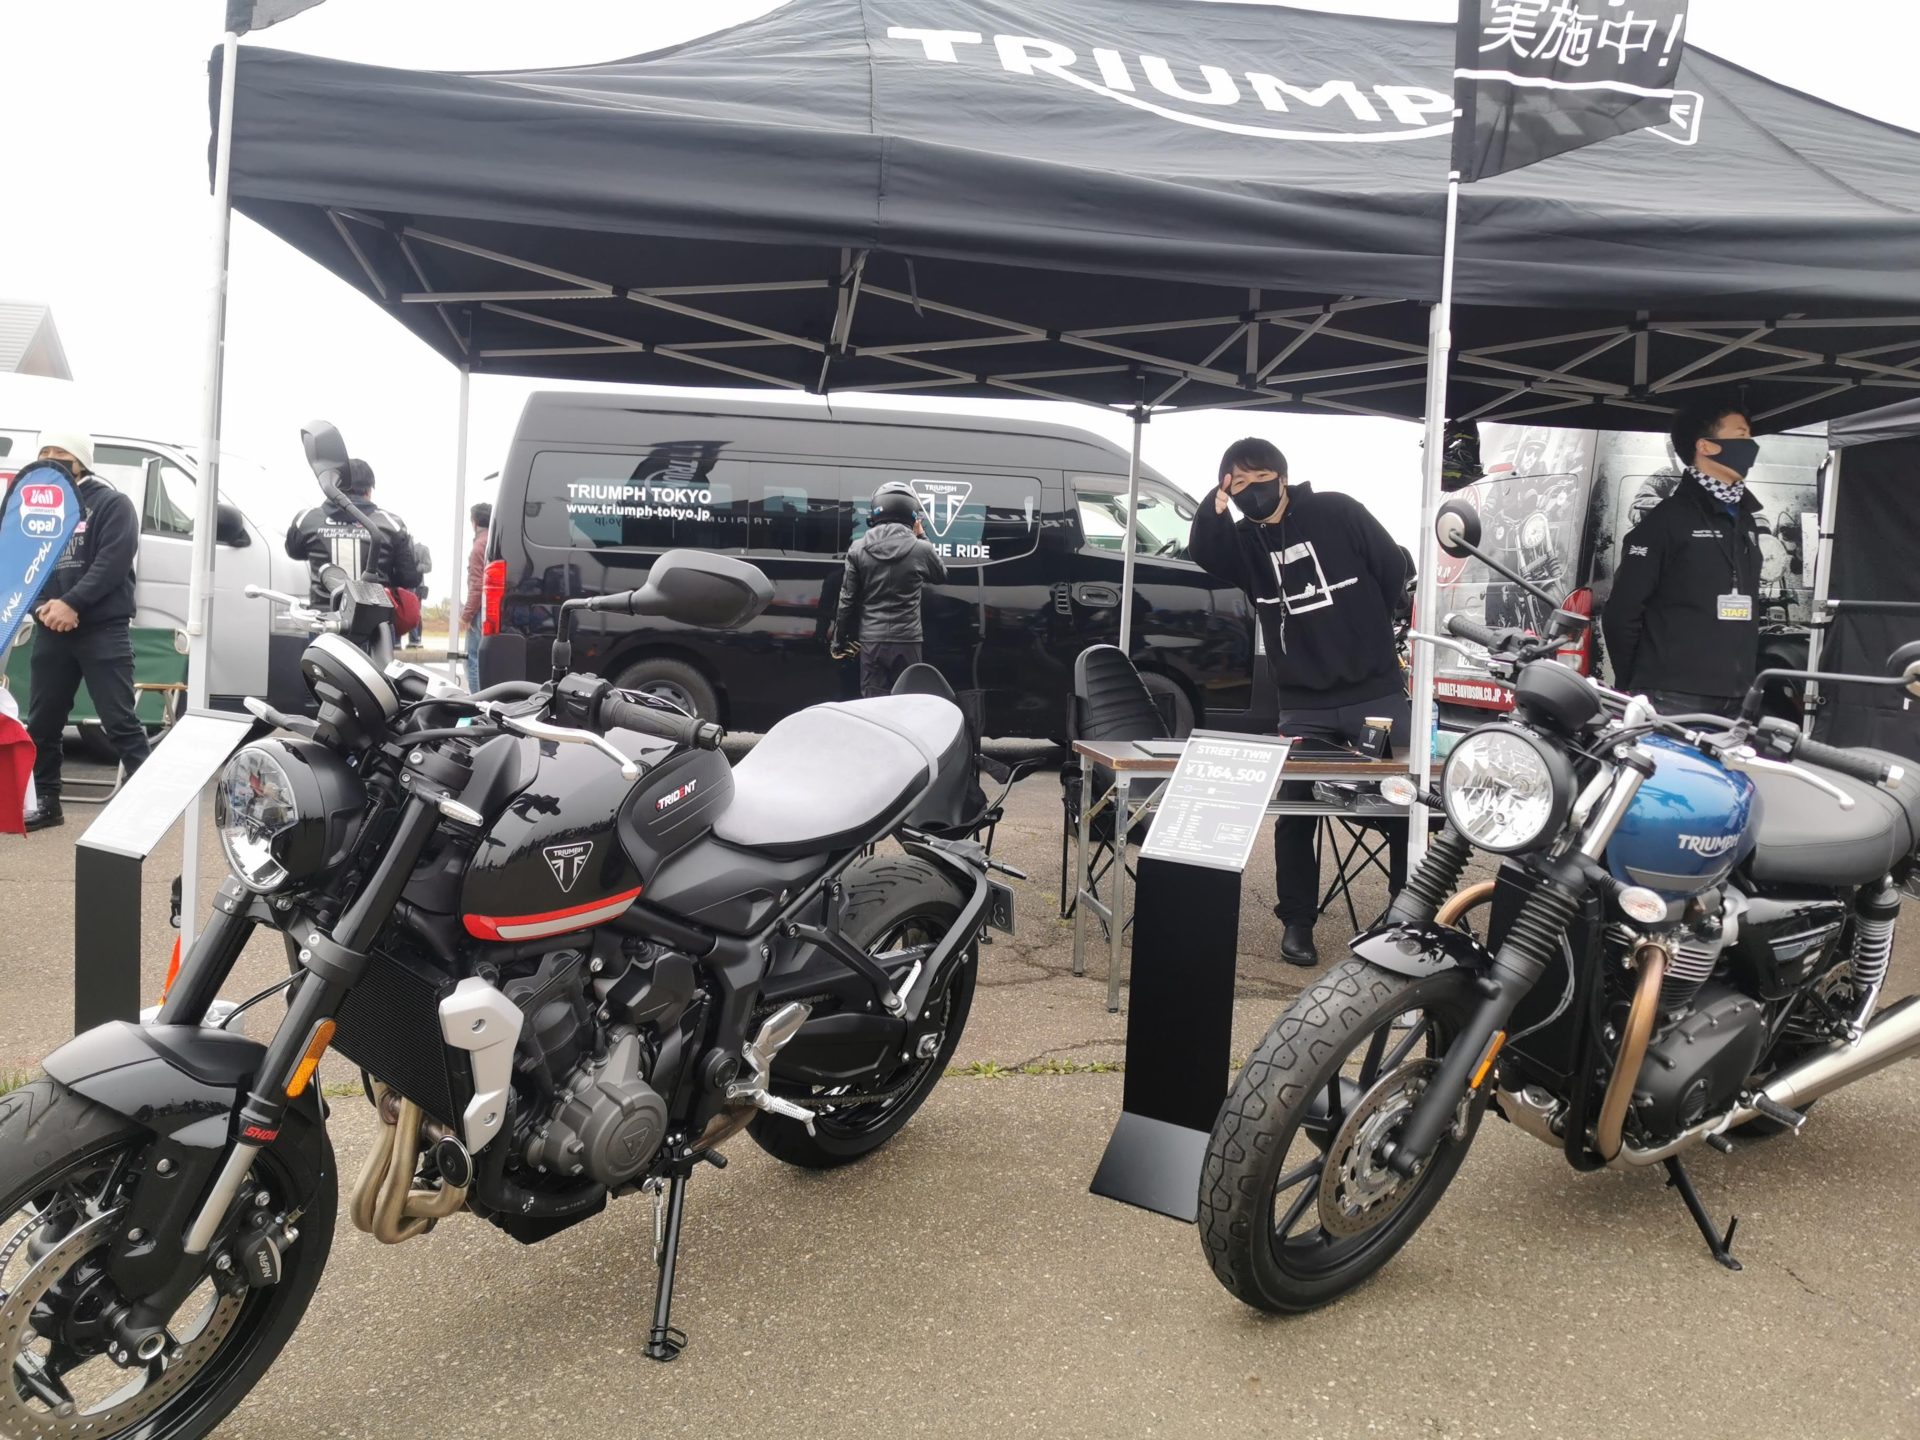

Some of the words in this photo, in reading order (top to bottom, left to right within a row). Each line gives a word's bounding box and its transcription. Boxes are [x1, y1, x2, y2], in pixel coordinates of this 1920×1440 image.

[1479, 0, 1684, 67] 実施中!
[887, 27, 1457, 141] TRIUMP
[567, 483, 647, 502] TRIUMPH
[651, 487, 712, 504] TOKYO
[924, 484, 957, 494] TRIUMPH
[566, 503, 711, 521] www.triumph-tokyo.jp
[28, 517, 55, 534] opal
[931, 543, 952, 557] HE
[956, 544, 990, 559] RIDE
[1721, 607, 1749, 618] STAFF
[1438, 682, 1501, 703] HARLEY-DAVIDSON.CO.JP
[1196, 744, 1240, 758] STREET
[1243, 749, 1272, 760] TWIN
[657, 779, 697, 810] TRIDENT
[553, 846, 584, 857] TRIUMPH
[1678, 833, 1740, 855] TRIUMPH
